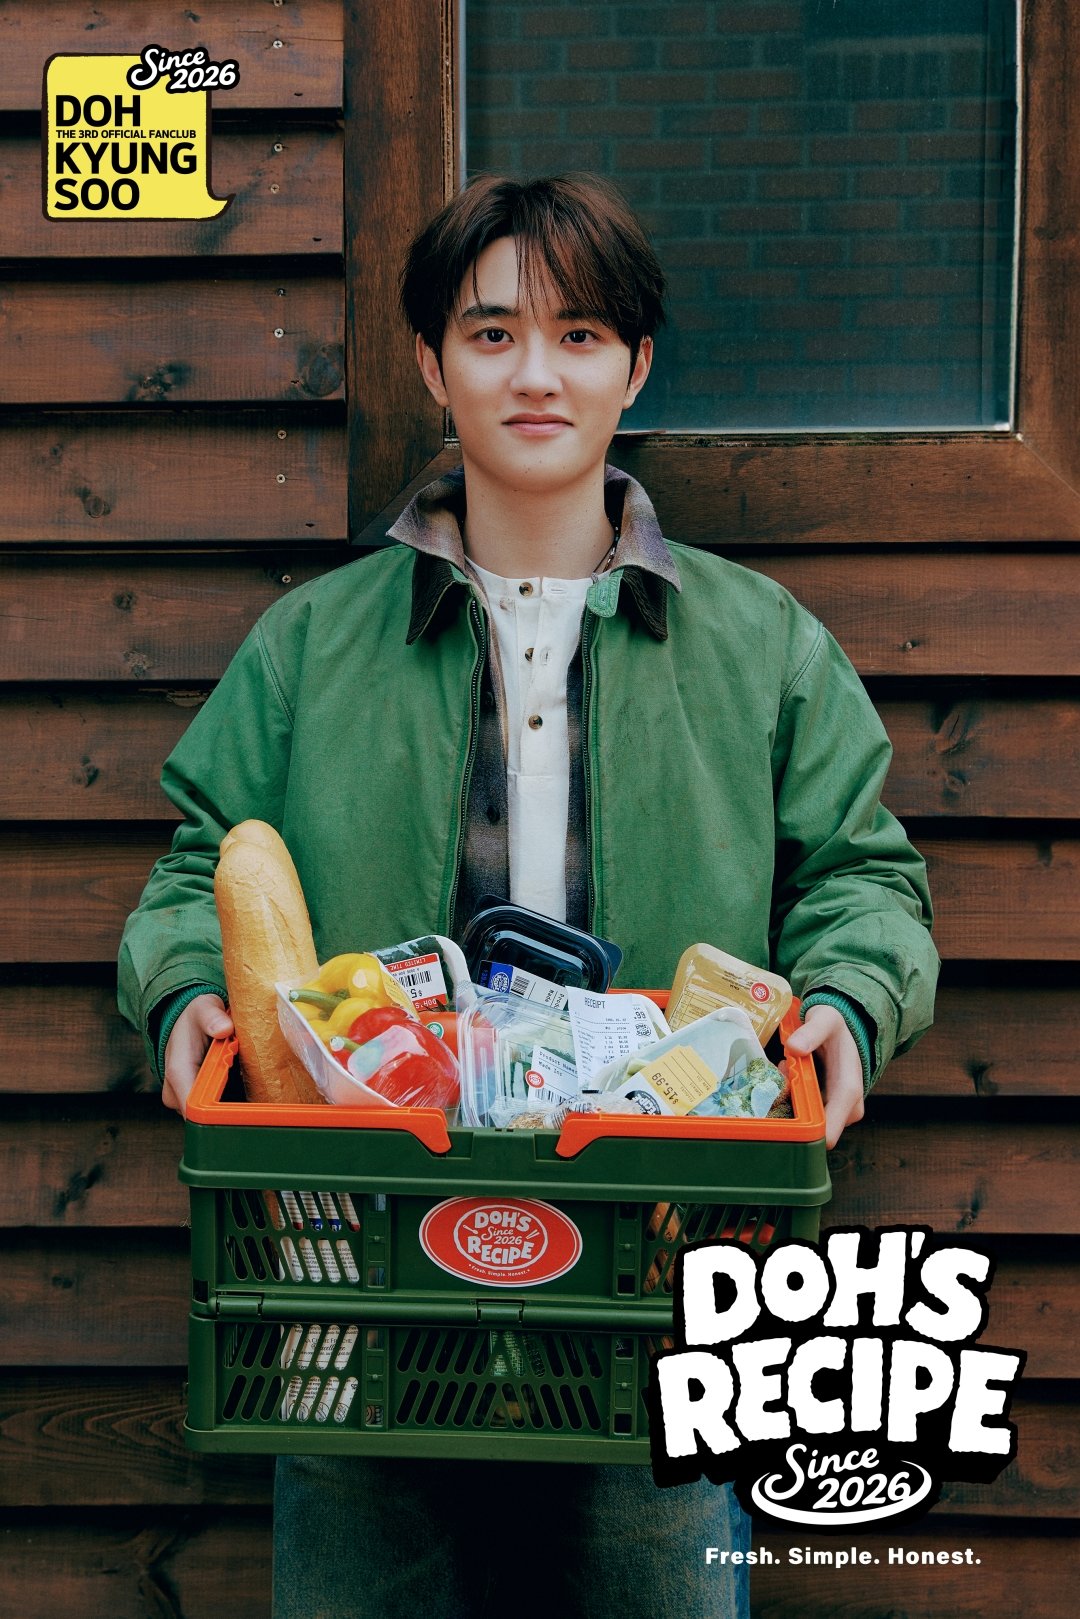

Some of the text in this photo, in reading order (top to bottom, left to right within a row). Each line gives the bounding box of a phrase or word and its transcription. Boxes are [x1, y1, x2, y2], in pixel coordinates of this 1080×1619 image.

[404, 957, 426, 967] LIMITED
[584, 997, 605, 1009] RECEIPT
[652, 1072, 679, 1105] $15.99
[474, 1210, 531, 1232] DOH'S
[481, 1226, 514, 1241] Since
[493, 1235, 522, 1245] 2026
[467, 1236, 534, 1265] RECIPE
